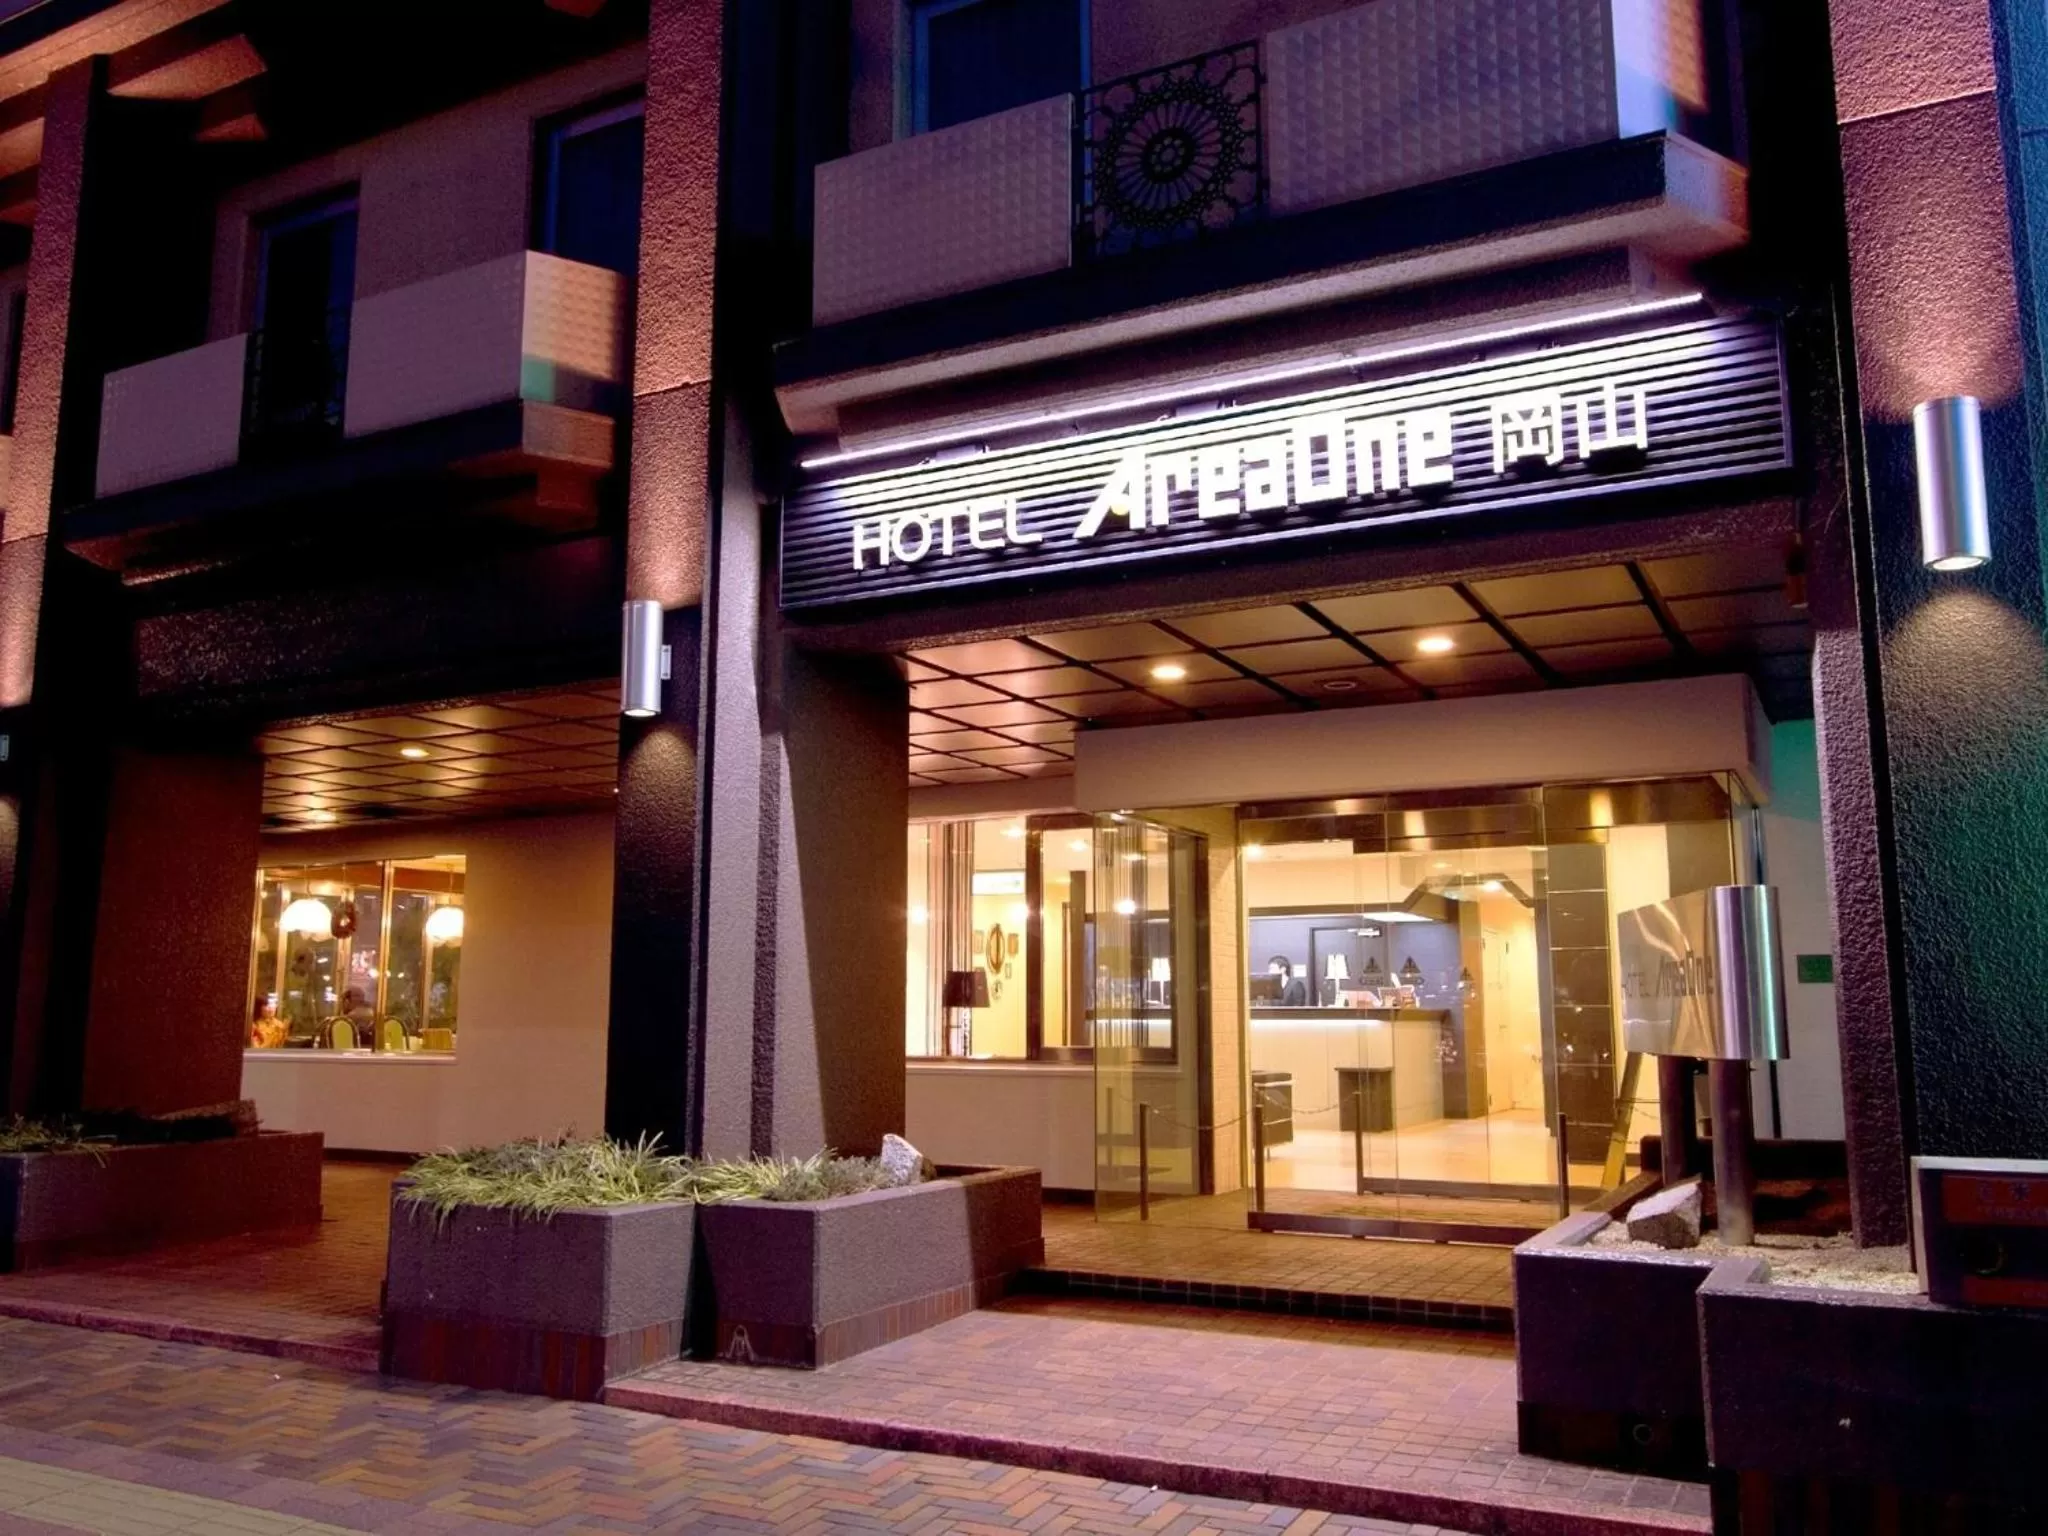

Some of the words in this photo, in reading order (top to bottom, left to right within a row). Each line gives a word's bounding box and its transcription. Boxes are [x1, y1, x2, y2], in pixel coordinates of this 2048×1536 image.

[853, 495, 1043, 570] HOTEL
[1073, 411, 1454, 539] AreaOne
[1491, 383, 1649, 473] 岡山
